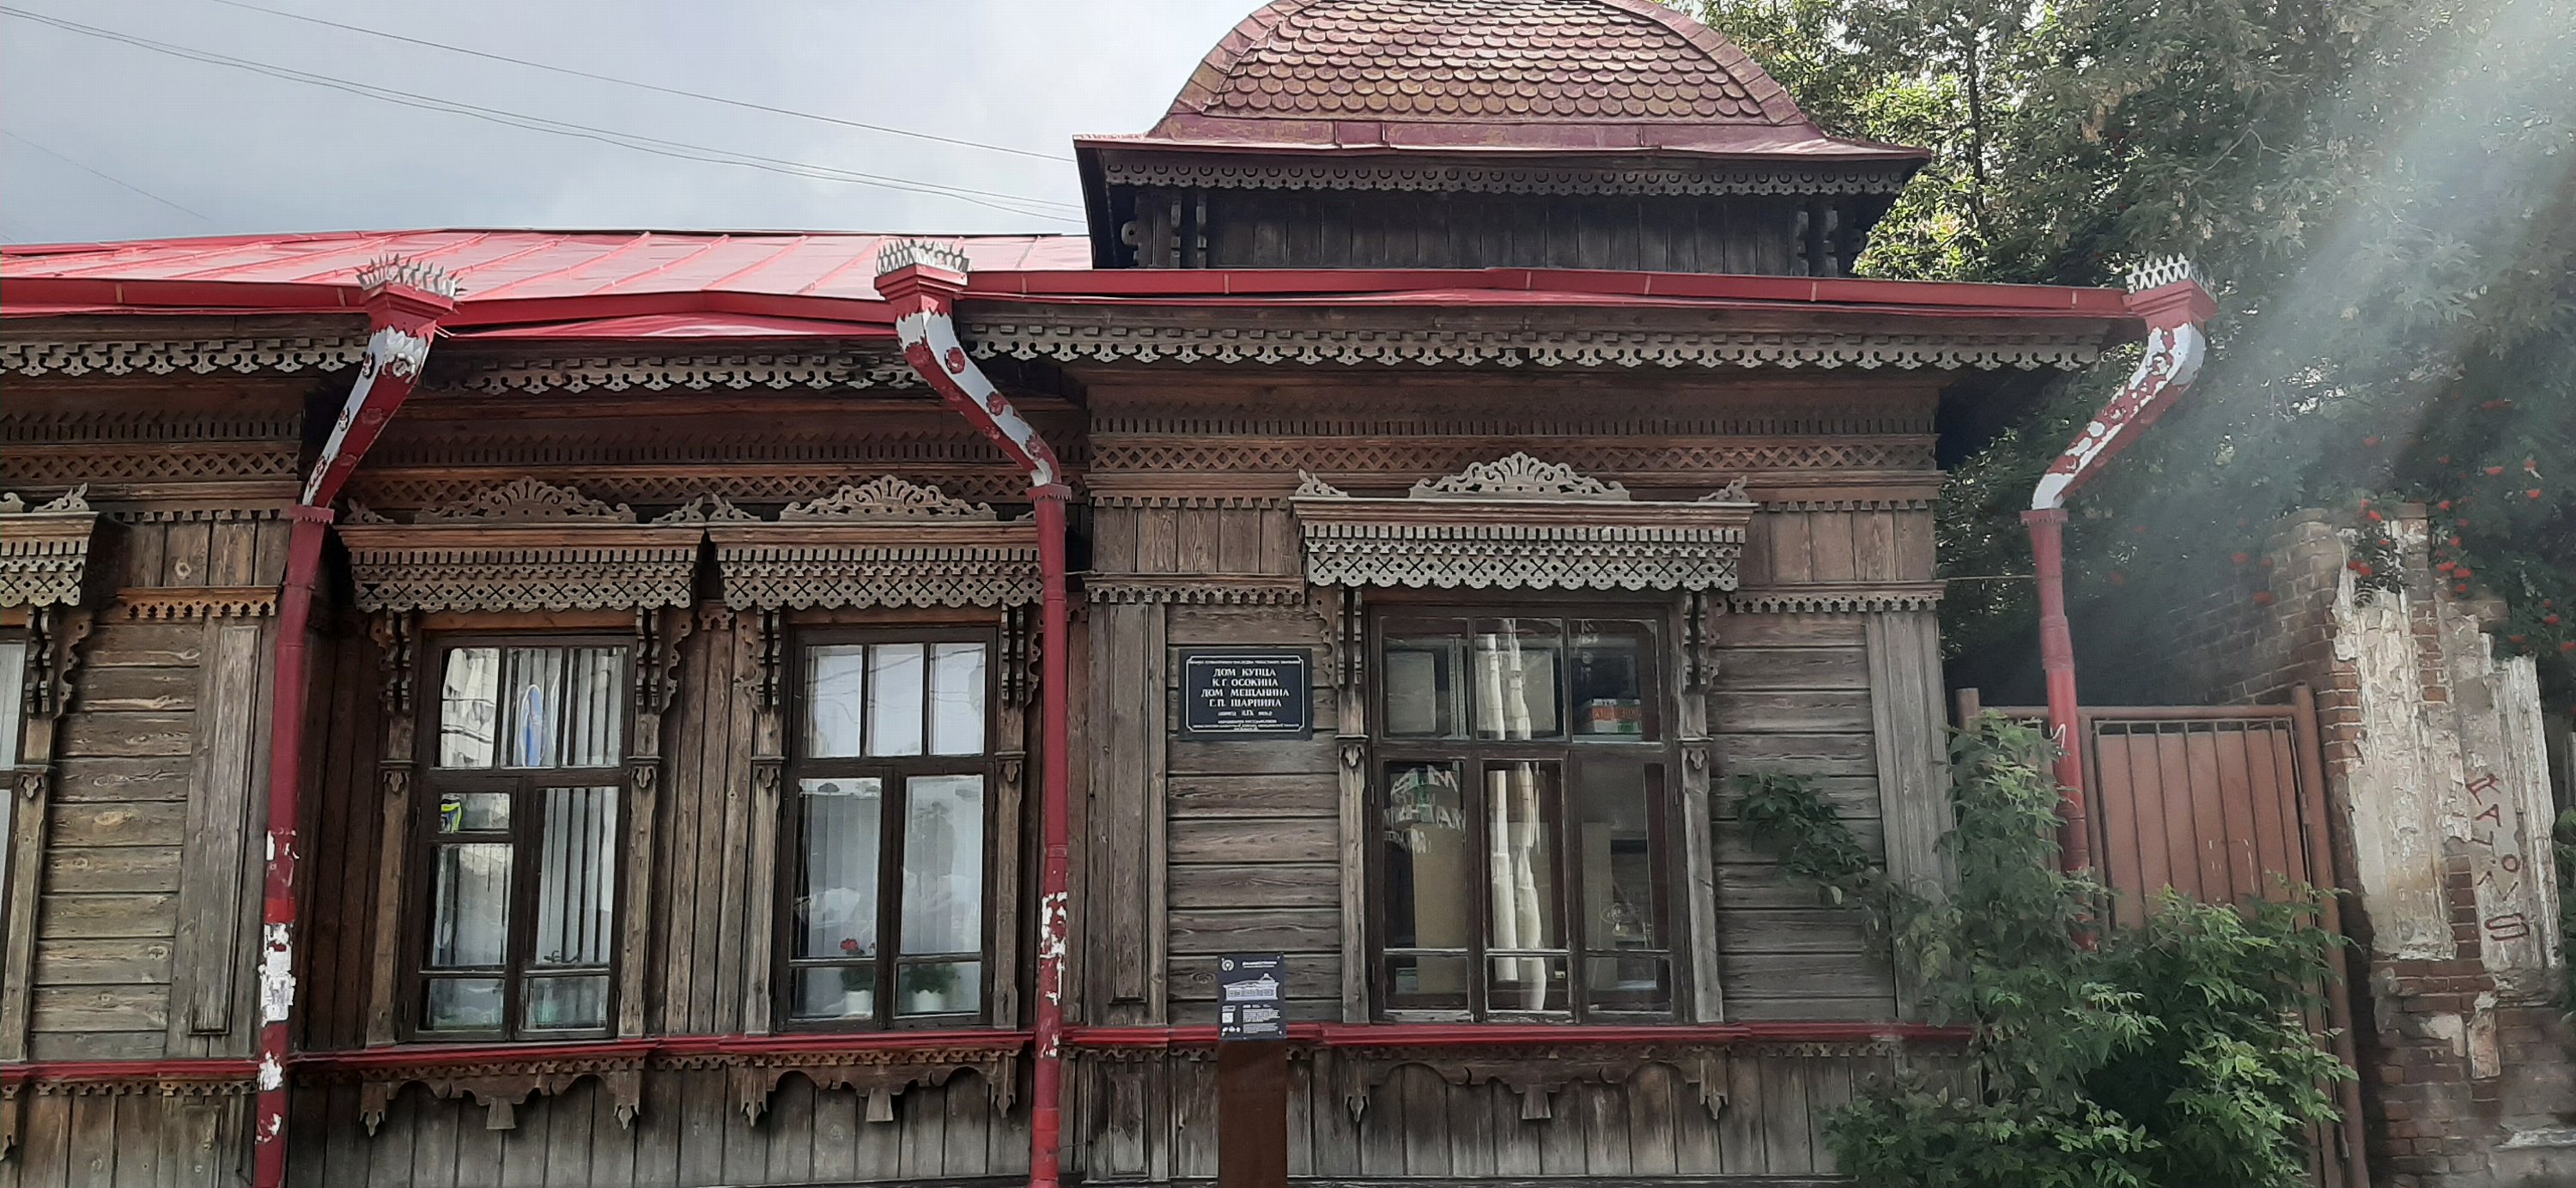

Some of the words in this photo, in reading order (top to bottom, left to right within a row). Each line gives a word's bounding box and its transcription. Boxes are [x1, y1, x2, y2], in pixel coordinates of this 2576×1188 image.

[1213, 668, 1236, 677] ДОМ
[1242, 668, 1276, 677] КУПЦА
[1230, 678, 1279, 687] ОСОКИНА
[1200, 688, 1224, 698] ДОМ
[1230, 688, 1290, 698] МЕЩАНИНА
